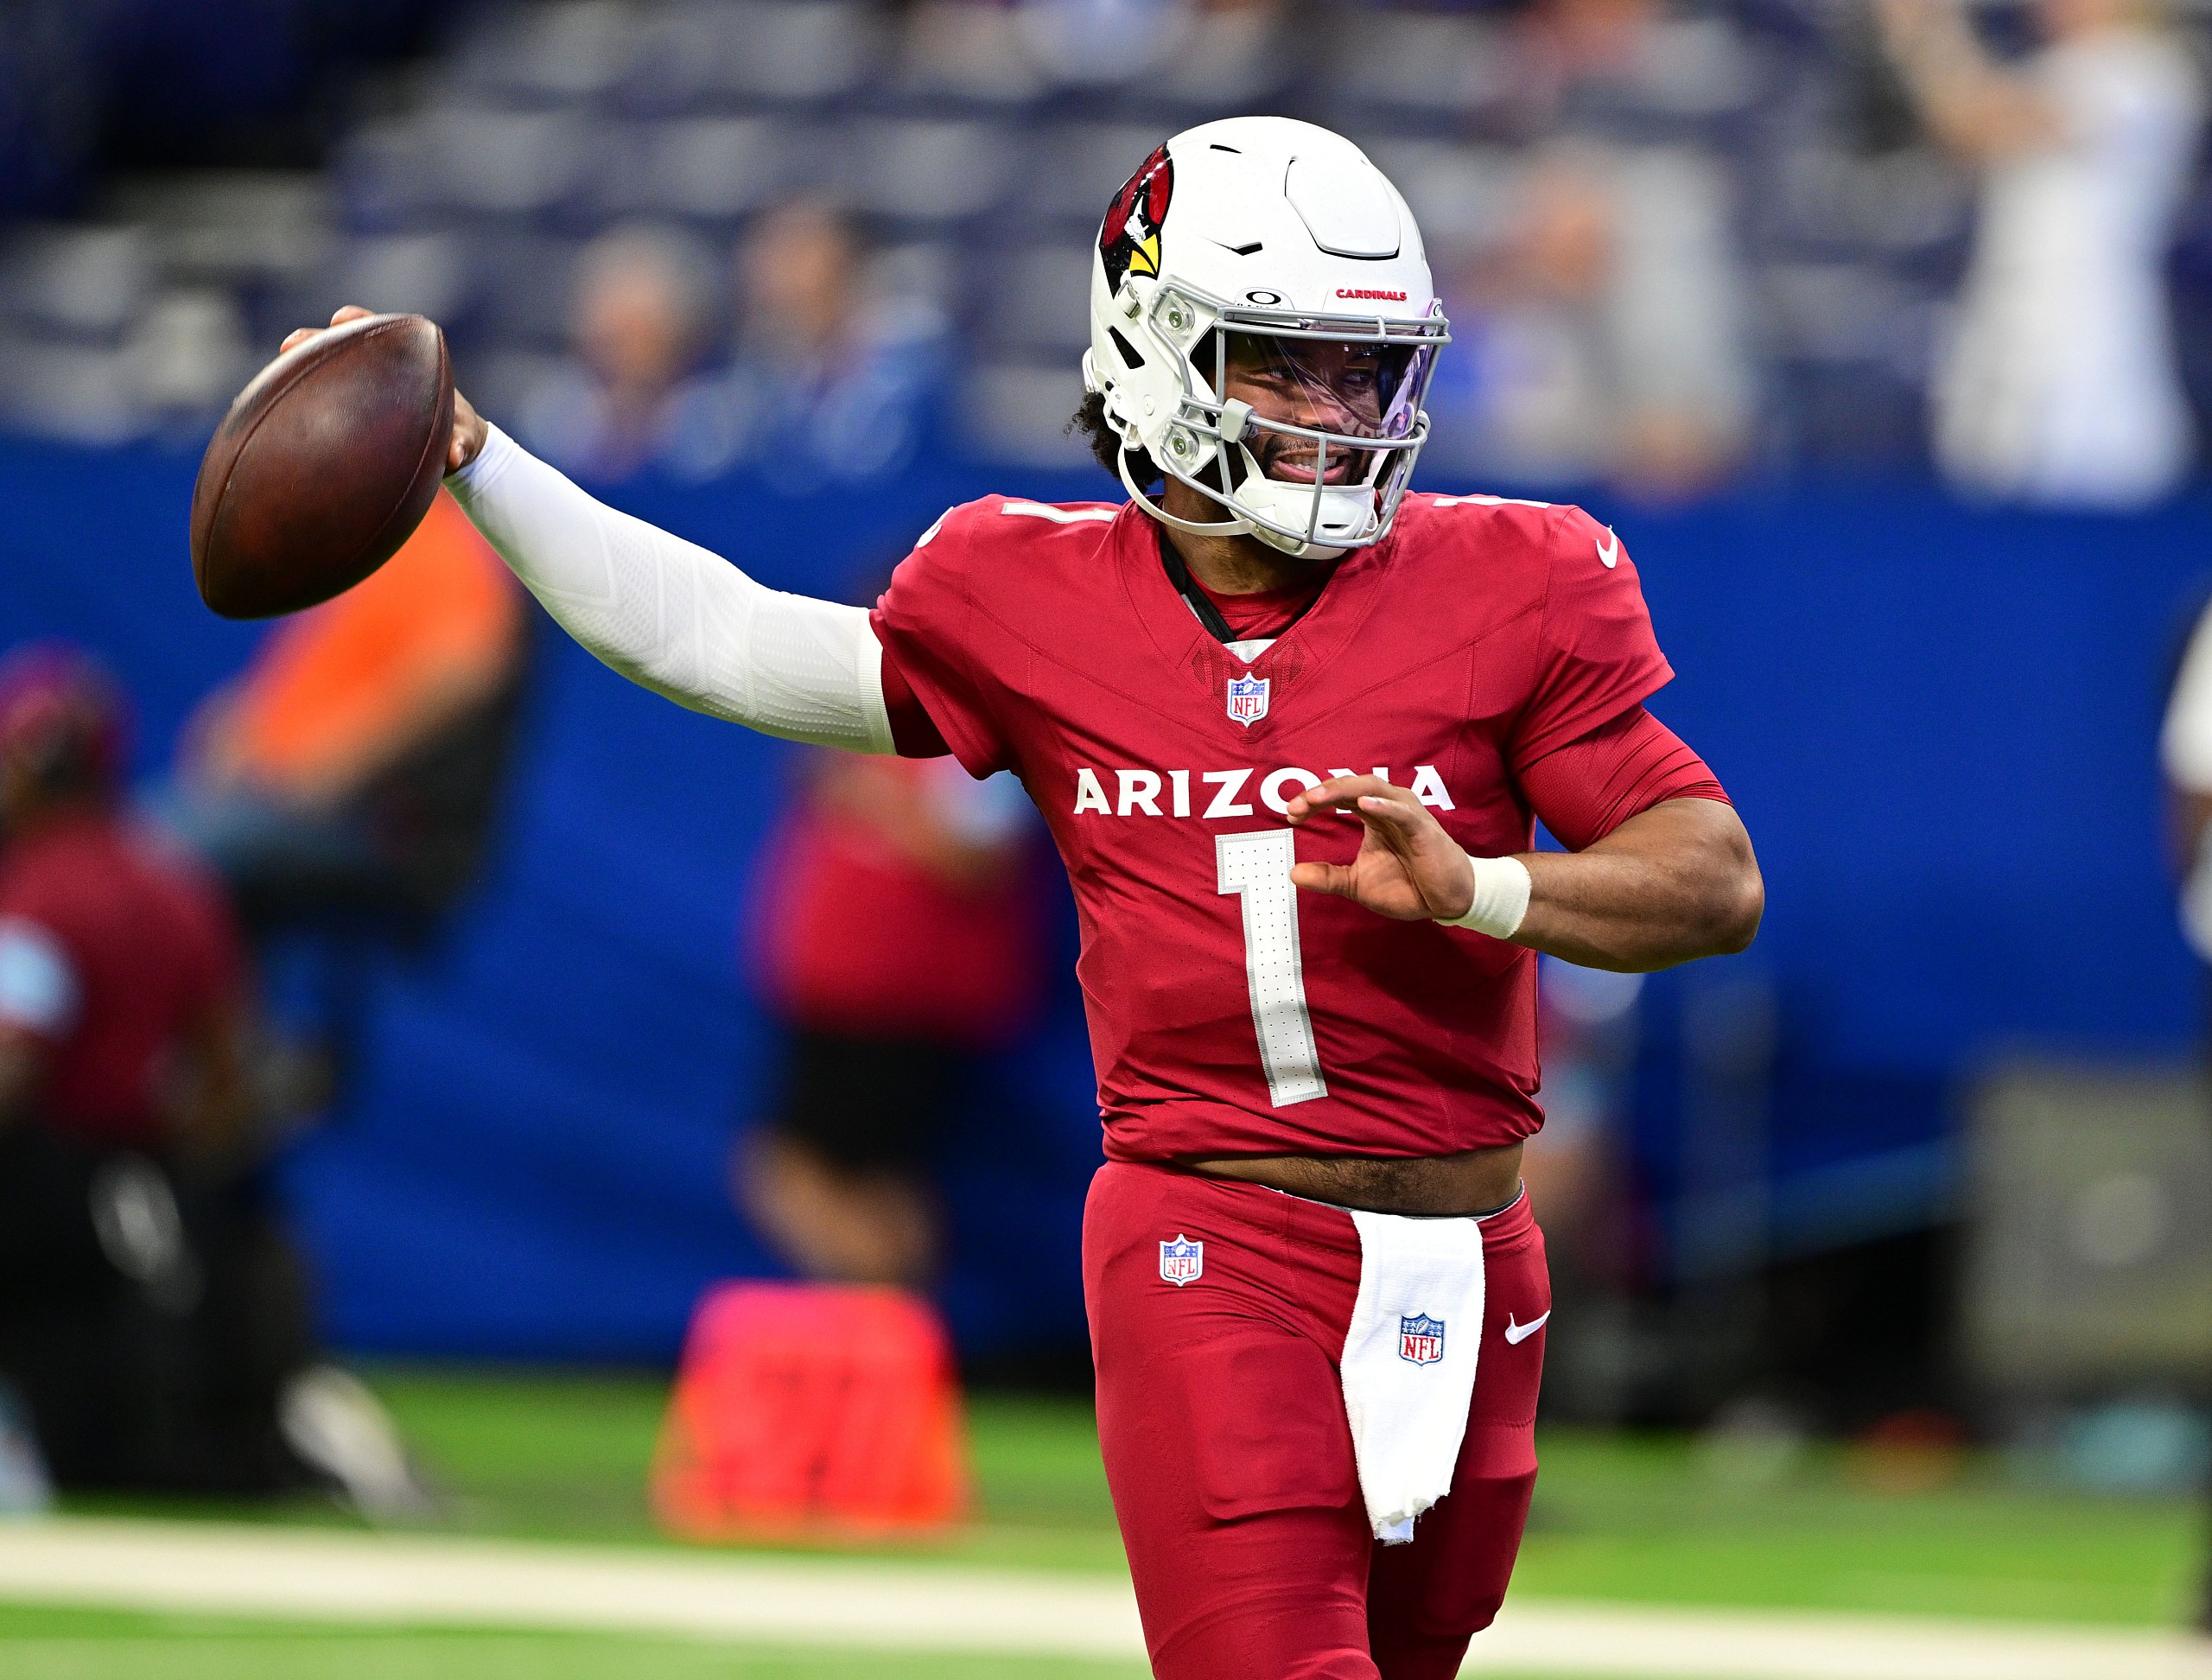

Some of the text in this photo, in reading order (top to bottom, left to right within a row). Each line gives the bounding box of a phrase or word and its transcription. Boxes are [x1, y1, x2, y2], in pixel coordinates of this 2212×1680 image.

[1335, 289, 1407, 302] CARDINALS
[1233, 697, 1261, 716] NFL
[1215, 828, 1328, 1108] 1
[1167, 1259, 1195, 1276] NFL
[1403, 1335, 1440, 1361] NFL
